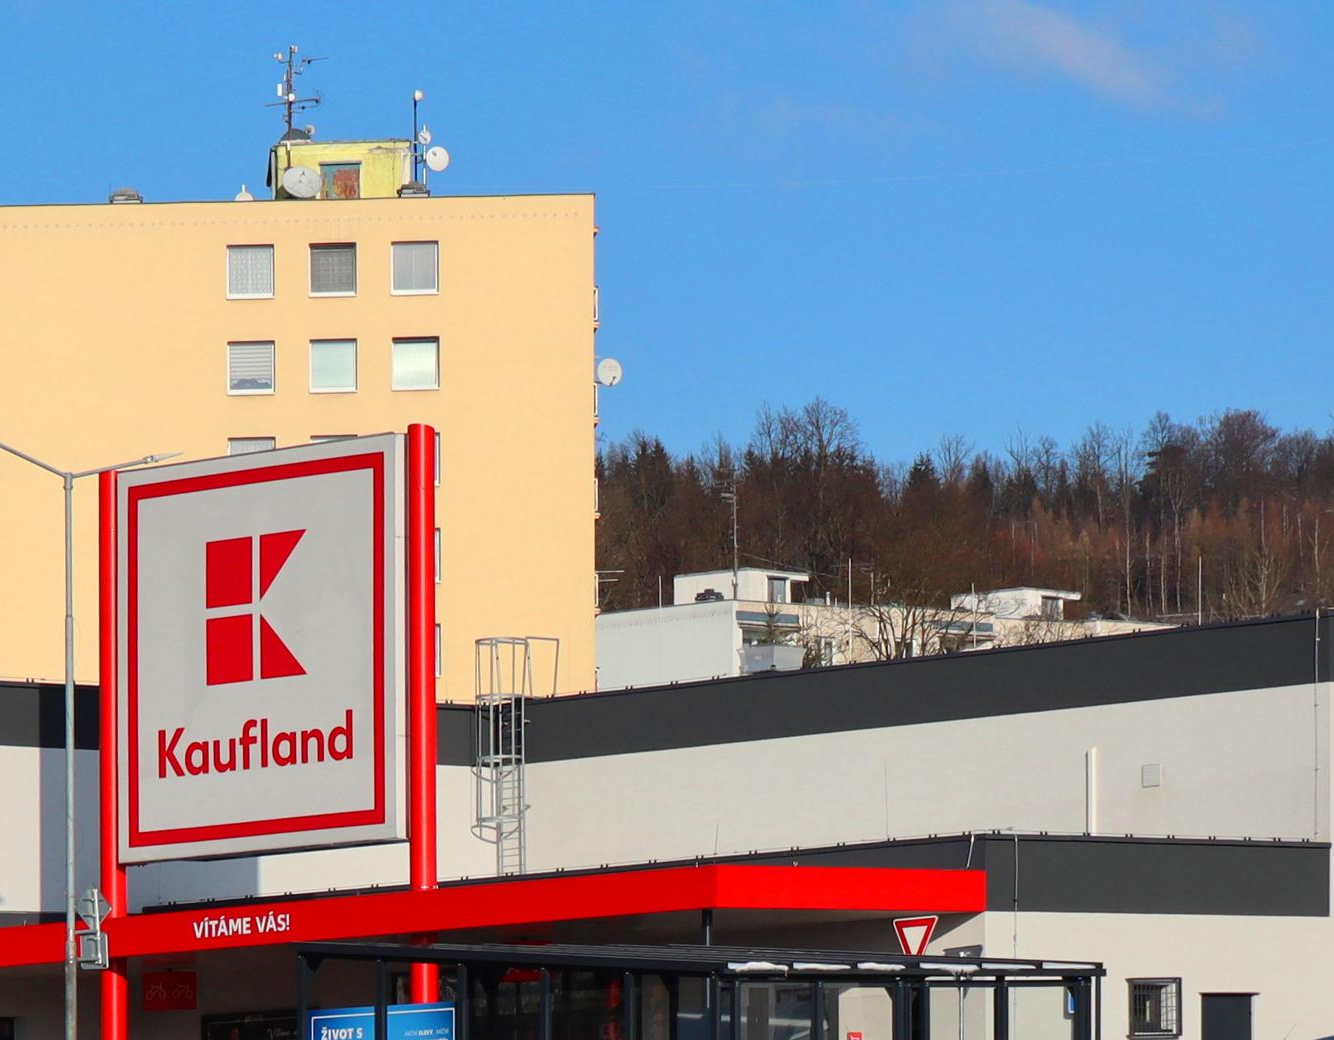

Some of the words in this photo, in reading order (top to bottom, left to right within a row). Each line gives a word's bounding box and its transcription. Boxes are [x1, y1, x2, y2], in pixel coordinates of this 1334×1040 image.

[158, 709, 354, 779] Kaufland
[193, 916, 251, 939] VÍTÁME
[255, 911, 290, 934] VÁS!
[356, 1027, 363, 1039] S
